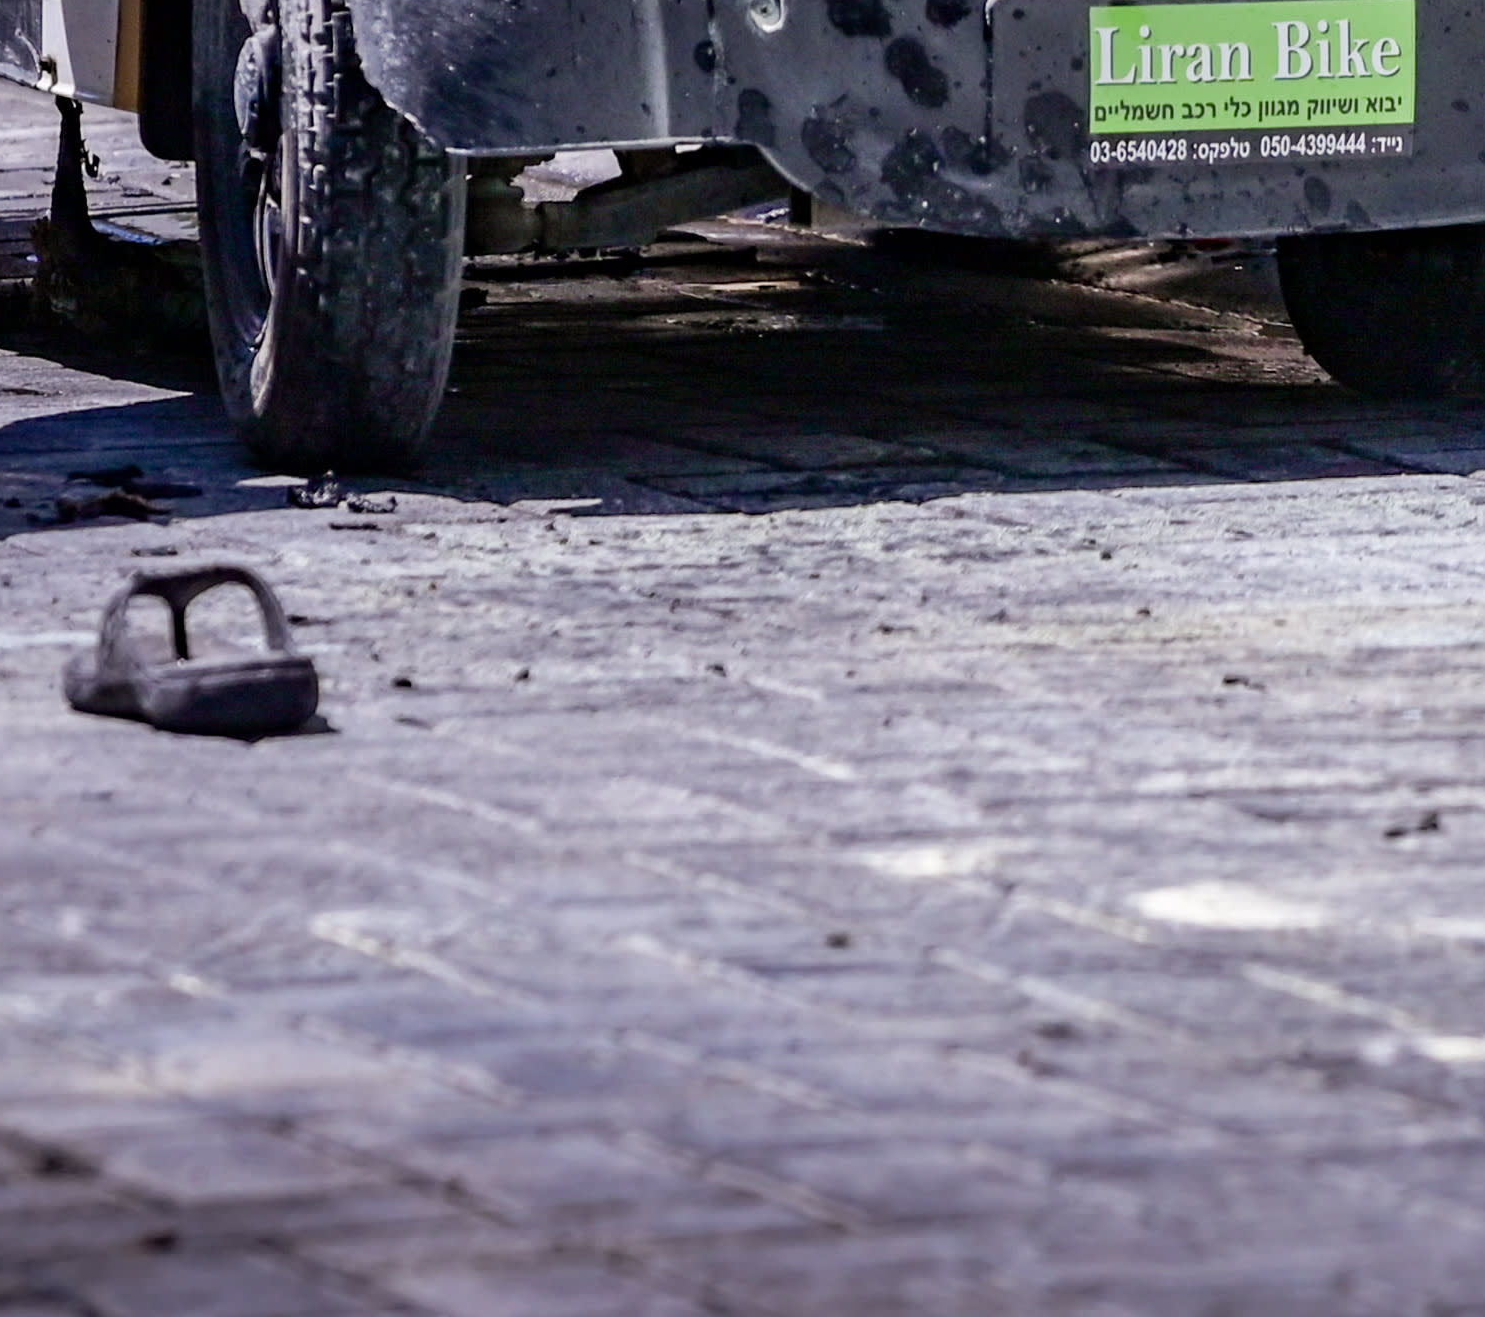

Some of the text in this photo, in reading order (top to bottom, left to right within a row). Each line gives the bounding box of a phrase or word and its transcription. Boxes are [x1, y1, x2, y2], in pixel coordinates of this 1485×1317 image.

[1094, 18, 1402, 85] Liran Bike
[1094, 96, 1403, 122] יבוא ושיווק מגוון כלי רכב חשמליים
[1090, 138, 1187, 164] 03-6540428
[1260, 132, 1366, 158] 050-4399444
